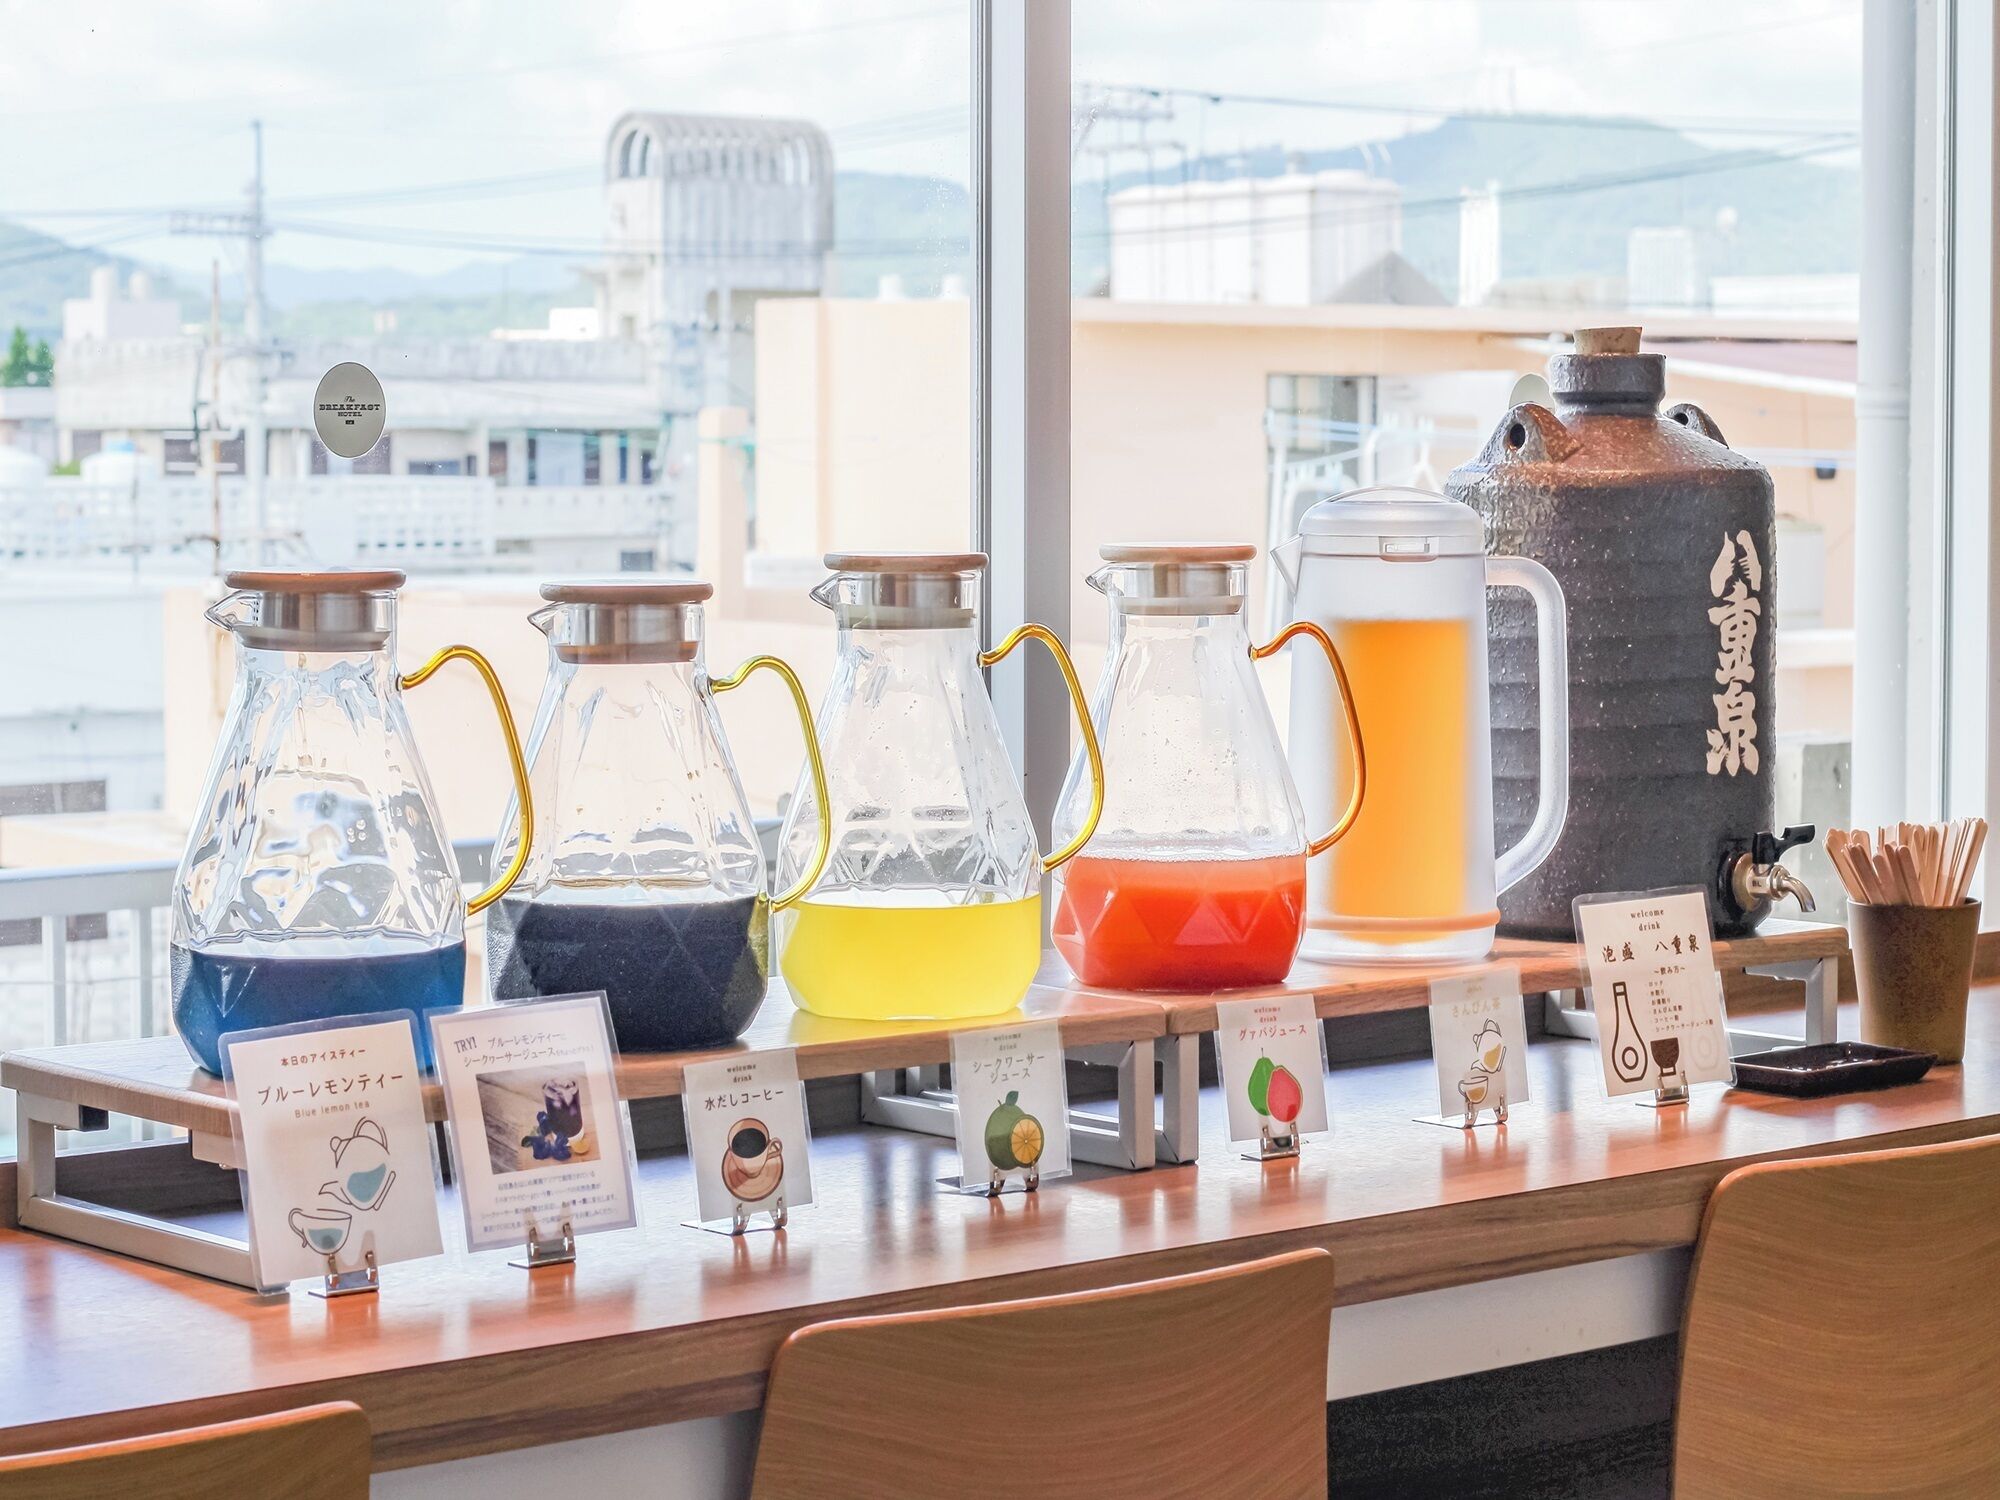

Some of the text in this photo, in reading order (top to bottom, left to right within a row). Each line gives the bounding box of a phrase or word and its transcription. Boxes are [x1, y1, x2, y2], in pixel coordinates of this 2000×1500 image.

[1706, 530, 1762, 777] 八重泉
[1630, 908, 1665, 919] welcome
[1638, 921, 1661, 932] drink
[1602, 933, 1700, 963] 泡盛 八重泉
[1254, 1006, 1281, 1014] welcome
[1239, 1024, 1307, 1041] グァバジュース
[453, 1035, 478, 1055] TRY!
[280, 1049, 366, 1067] 本日のアイスティー
[726, 1063, 757, 1073] welcome
[990, 1067, 1031, 1084] ジュース
[732, 1074, 753, 1083] drink
[257, 1072, 404, 1106] ブルーレモンティー
[704, 1088, 784, 1111] 水だしコーヒー
[294, 1100, 371, 1119] Blue lemon tea
